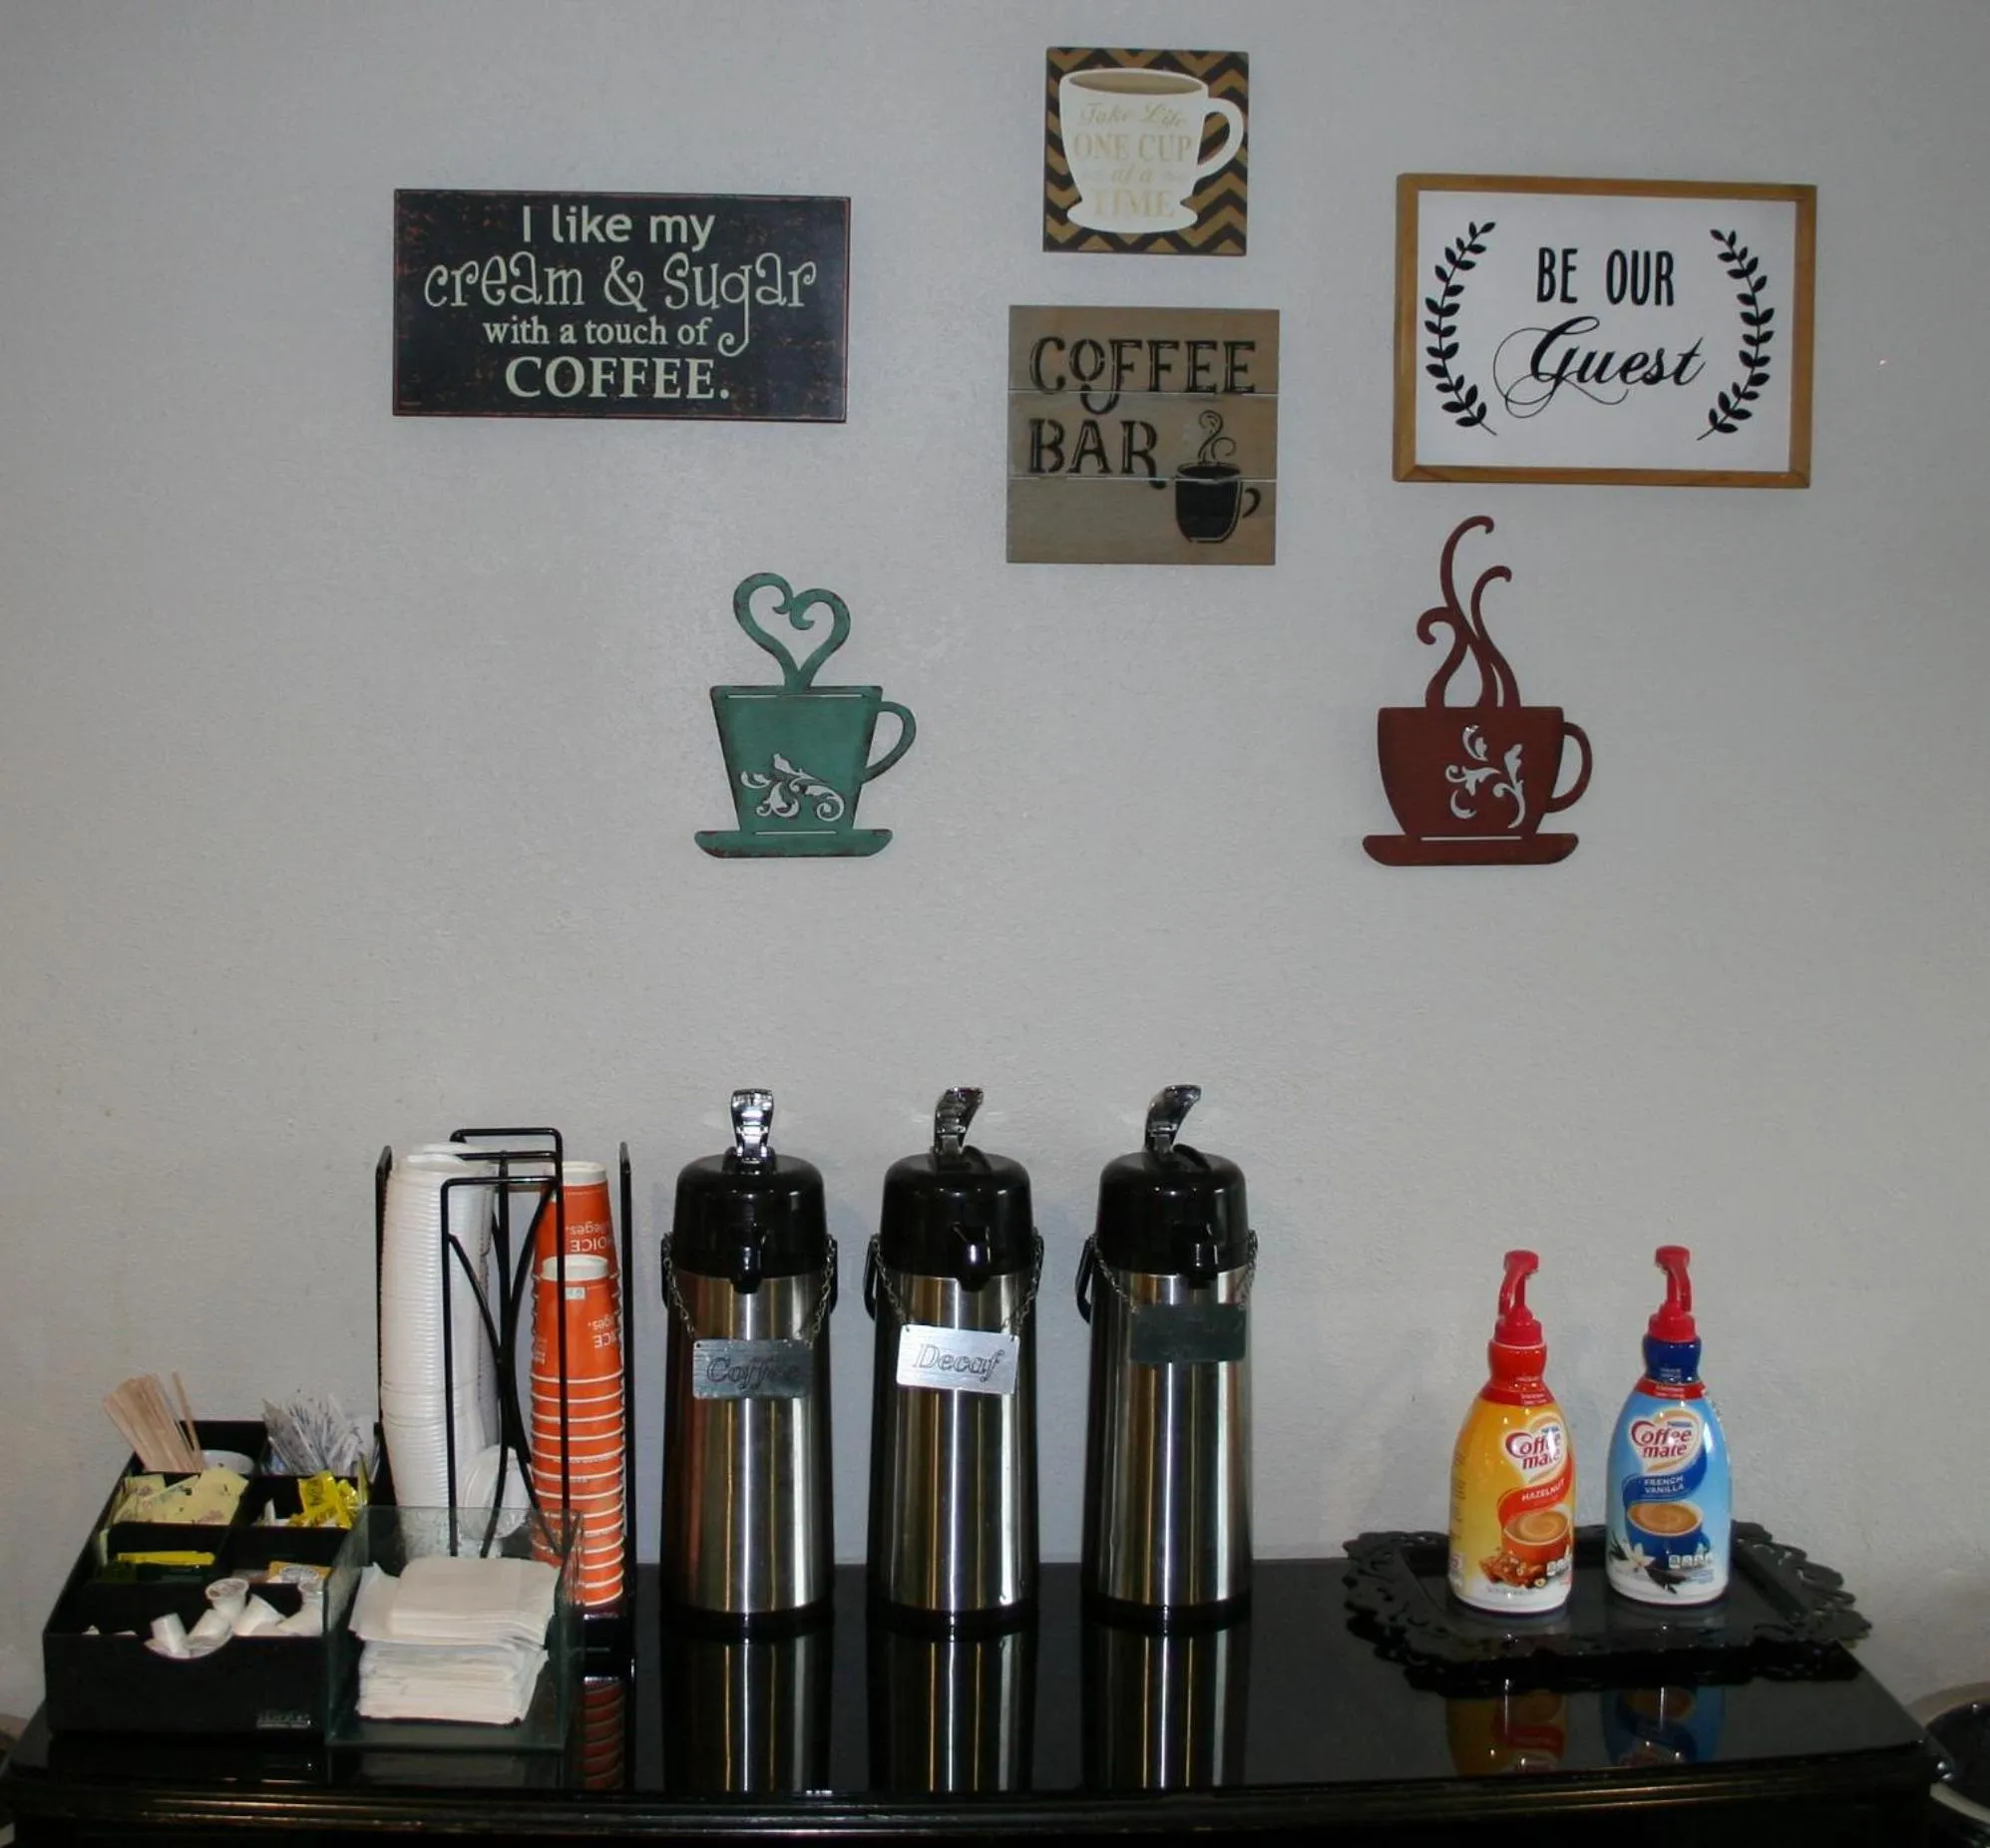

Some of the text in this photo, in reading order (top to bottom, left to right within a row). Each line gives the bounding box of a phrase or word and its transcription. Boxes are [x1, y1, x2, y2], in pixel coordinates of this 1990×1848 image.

[1078, 102, 1133, 126] Take
[1073, 134, 1192, 162] ONE CUP
[1089, 188, 1175, 218] TIME
[522, 204, 716, 252] I like my
[424, 250, 586, 308] cream
[603, 254, 649, 313] &
[1536, 246, 1675, 306] BE OUR
[482, 315, 711, 346] with a touch of
[505, 355, 730, 401] COFFEE.
[1029, 336, 1257, 415] COFFEE
[1493, 315, 1708, 419] Guest
[1028, 418, 1167, 490] BAR
[912, 1342, 1005, 1383] Decaf
[1642, 1444, 1688, 1458] mate
[1643, 1475, 1684, 1486] FRENCH
[1644, 1484, 1685, 1494] VANILLA
